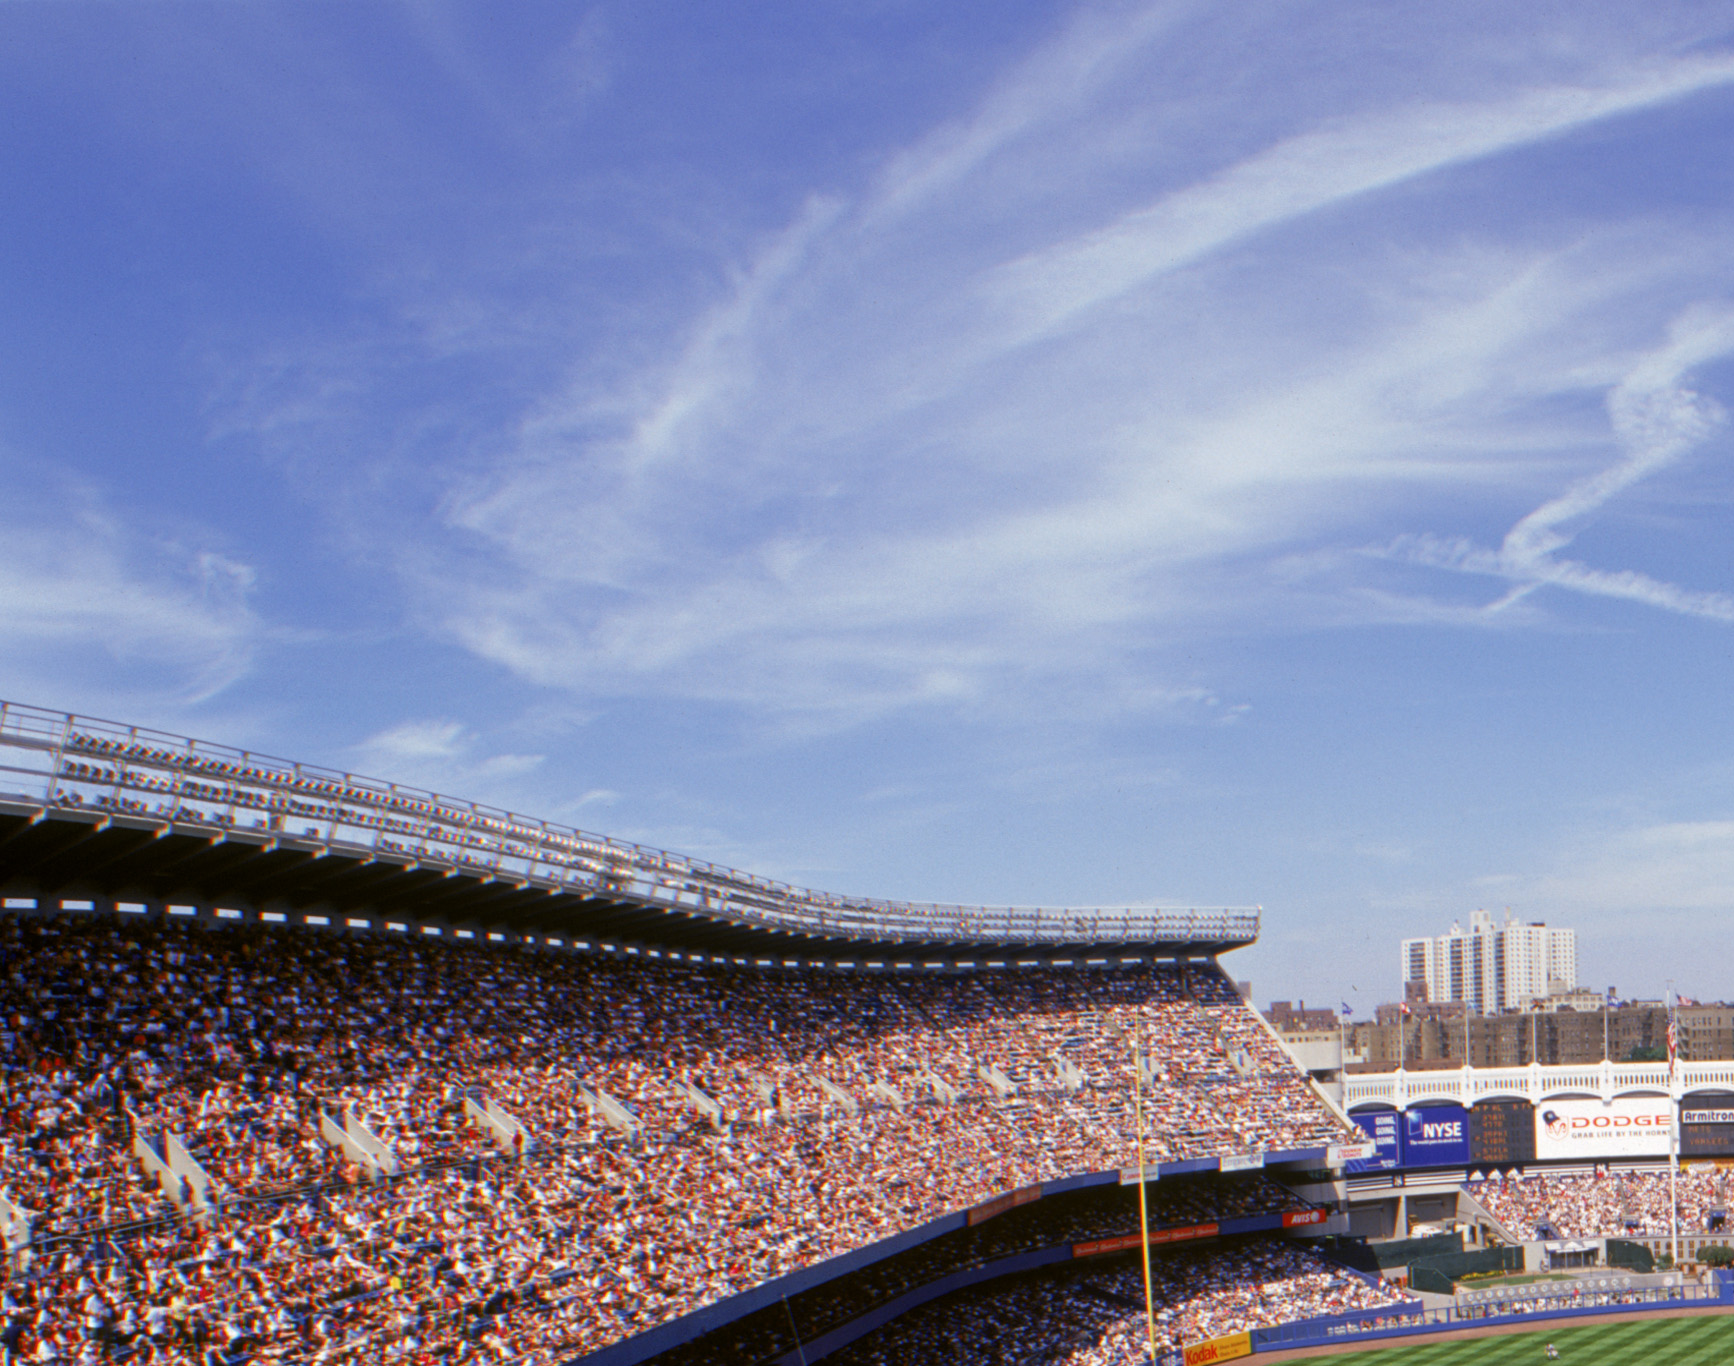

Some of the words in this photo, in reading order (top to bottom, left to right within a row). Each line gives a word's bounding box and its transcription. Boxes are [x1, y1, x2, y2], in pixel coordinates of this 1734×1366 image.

[1571, 1115, 1671, 1129] DODGE
[1684, 1111, 1734, 1122] Armitron
[1423, 1121, 1462, 1138] NYSE
[1291, 1213, 1310, 1225] AVIS
[1185, 1344, 1218, 1366] Kodak
